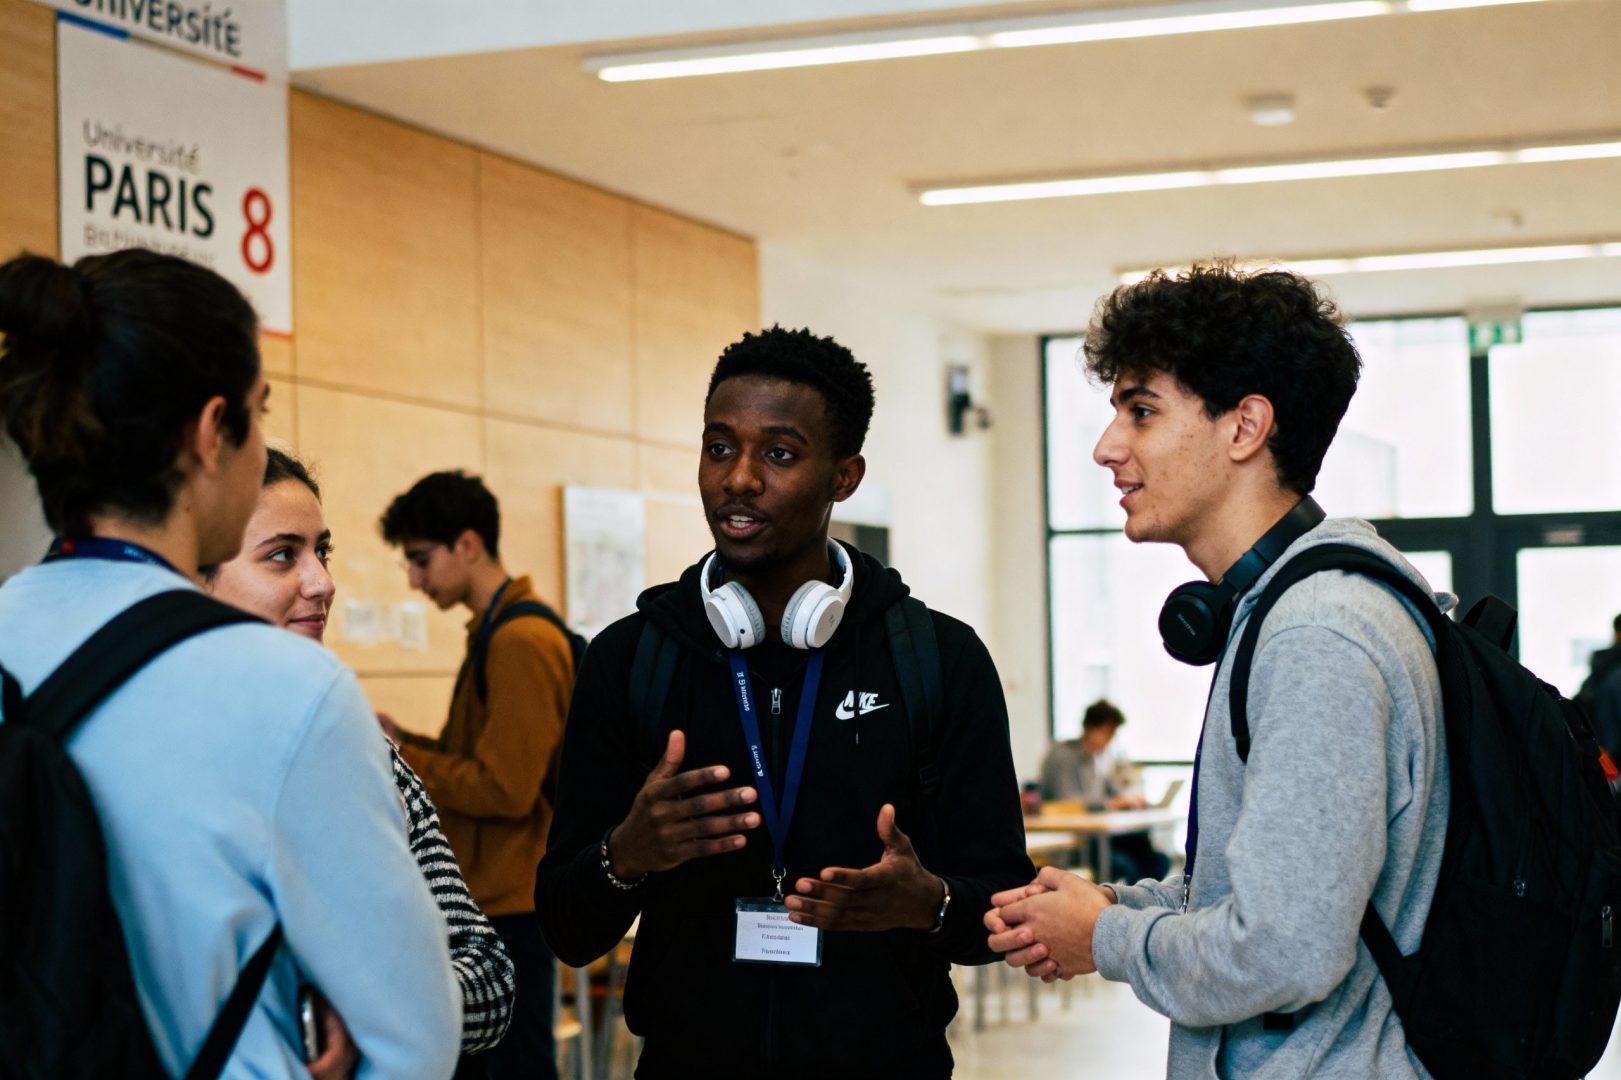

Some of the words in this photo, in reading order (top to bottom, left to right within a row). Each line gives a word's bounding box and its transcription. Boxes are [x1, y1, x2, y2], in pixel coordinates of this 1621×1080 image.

[83, 119, 200, 174] Université
[85, 154, 214, 239] PARIS
[241, 187, 275, 276] 8
